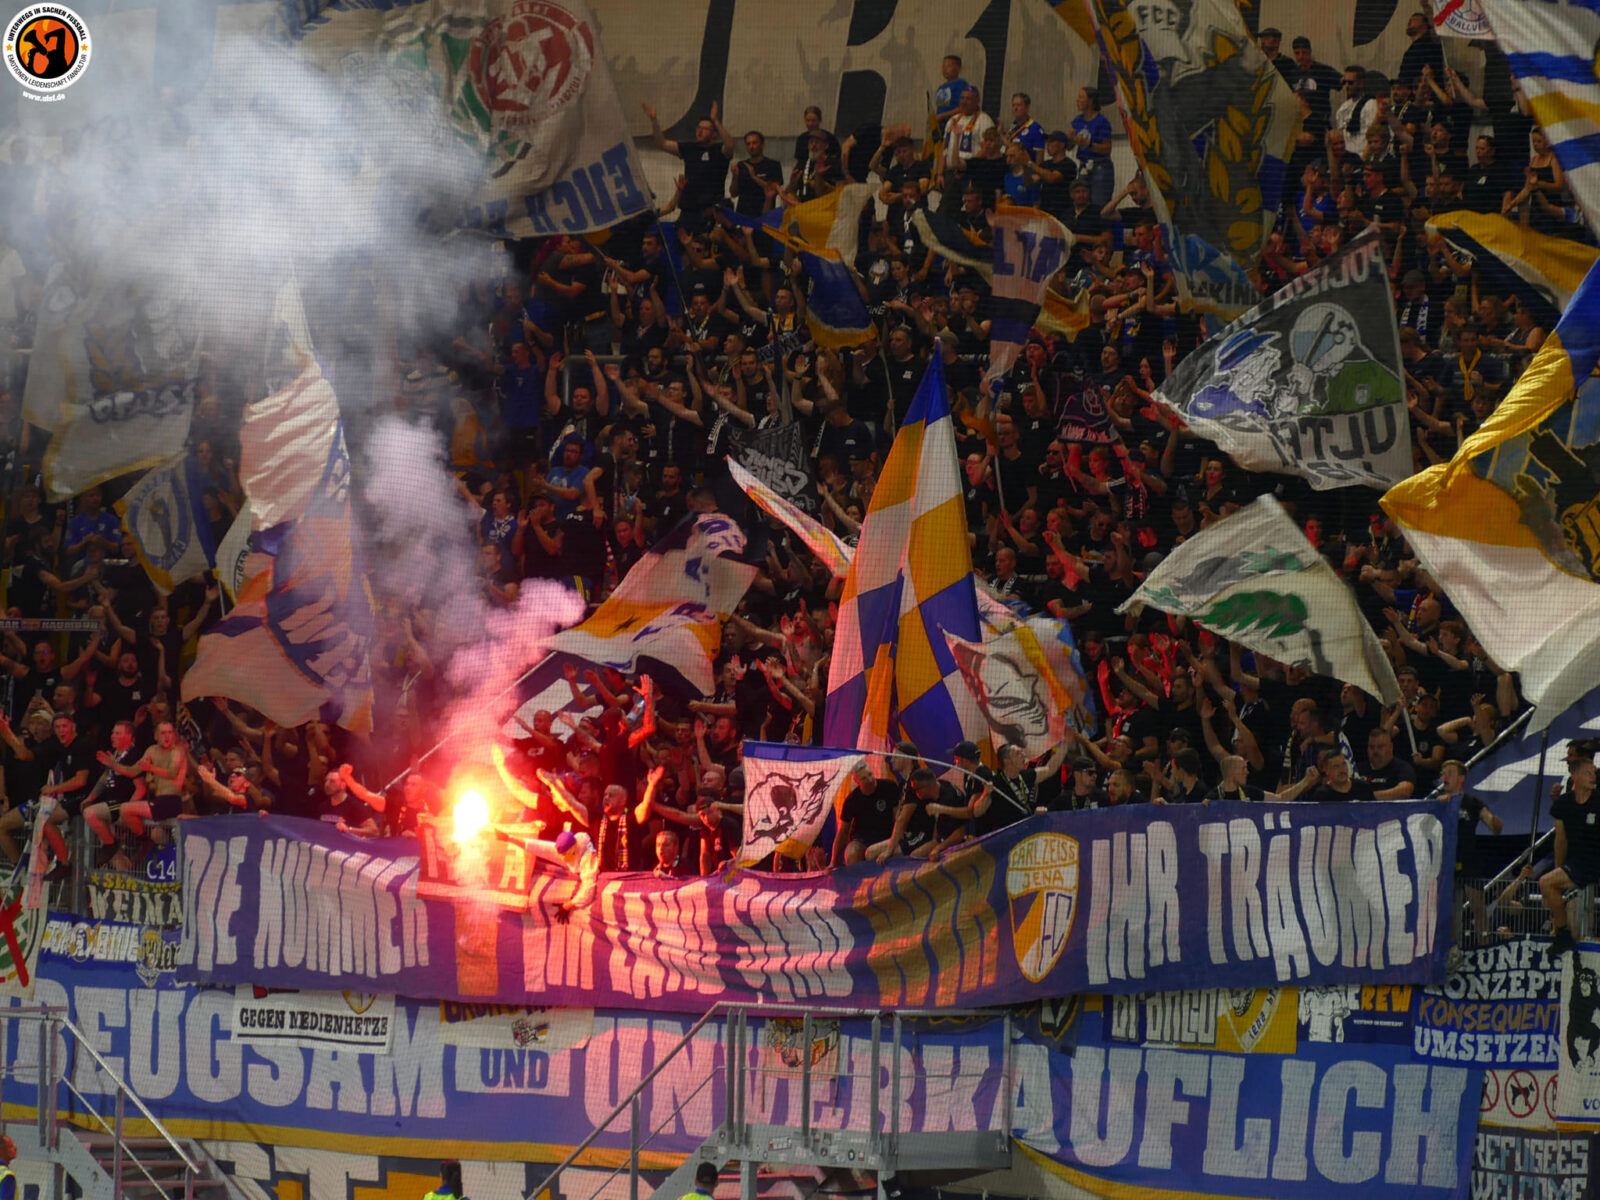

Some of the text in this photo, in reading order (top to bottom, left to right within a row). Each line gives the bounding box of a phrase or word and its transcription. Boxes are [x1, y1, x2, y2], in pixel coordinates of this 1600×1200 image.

[146, 860, 177, 881] C14
[1011, 837, 1076, 867] CARL ZEISS
[1021, 869, 1065, 890] JENA
[1086, 810, 1444, 986] IHR TRÄUMER
[175, 834, 248, 971] DIE
[852, 843, 999, 1007] WIR
[1038, 891, 1073, 973] FC
[1423, 969, 1562, 1001] ONZEPT
[239, 1007, 389, 1037] GEGEN MEDIENHETZE
[1418, 995, 1560, 1035] KONSEQUENT
[480, 1047, 550, 1090] UND
[1476, 1132, 1589, 1175] REFUGEES
